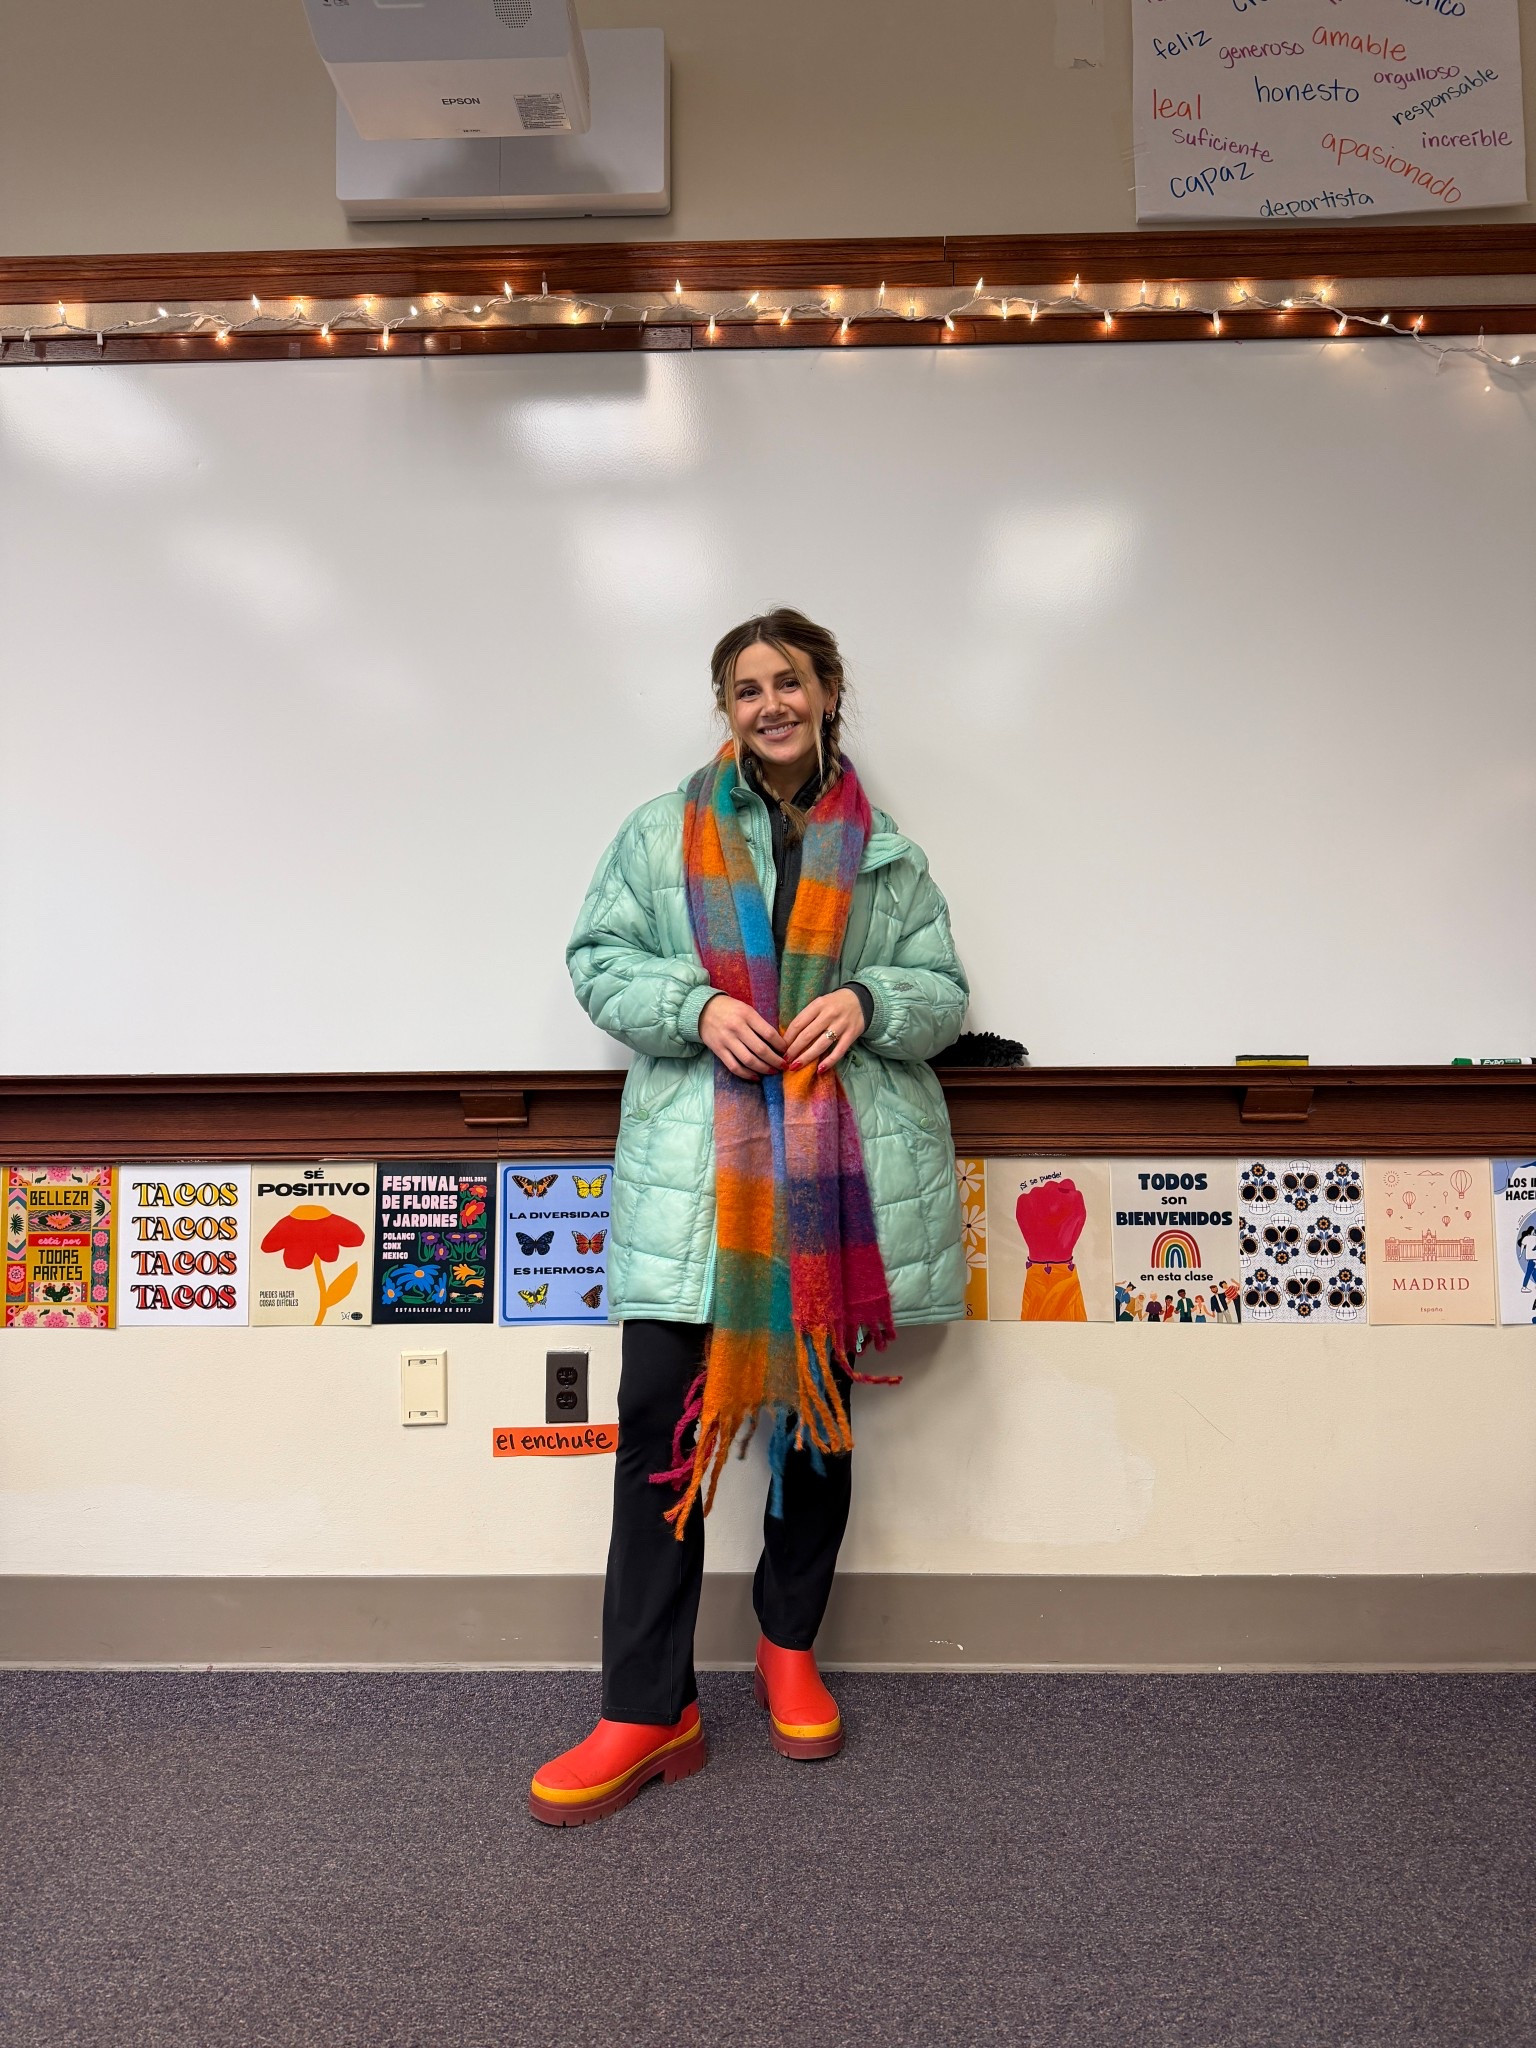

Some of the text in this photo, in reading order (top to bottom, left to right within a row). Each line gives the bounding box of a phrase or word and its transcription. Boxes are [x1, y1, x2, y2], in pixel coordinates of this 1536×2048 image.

[1154, 30, 1213, 60] feliz
[1312, 26, 1407, 62] amable
[1218, 40, 1305, 69] generoso
[1373, 64, 1460, 90] orgulloso
[1254, 76, 1360, 104] honesto
[1391, 67, 1499, 125] responsable
[441, 97, 480, 106] EPSON
[1153, 89, 1201, 121] leal
[1172, 127, 1274, 164] suficiente
[1421, 130, 1513, 149] increíble
[1321, 132, 1462, 204] apasionado
[1170, 161, 1254, 199] capaz
[1260, 187, 1374, 218] deportista
[304, 1167, 325, 1179] SÉ
[1039, 1171, 1063, 1183] puede!
[258, 1182, 370, 1196] POSITIVO
[383, 1175, 458, 1191] FESTIVAL
[1138, 1173, 1208, 1191] TODOS
[1507, 1177, 1527, 1188] LOS
[30, 1190, 89, 1206] BELLEZA
[132, 1182, 239, 1206] TACOS
[382, 1194, 458, 1210] DE FLORES
[1161, 1196, 1187, 1205] son
[1505, 1190, 1536, 1201] HACE
[382, 1213, 458, 1229] Y JARDINES
[509, 1211, 610, 1220] LA DIVERSIDAD
[1116, 1211, 1233, 1226] BIENVENIDOS
[132, 1216, 239, 1241] TACOS
[383, 1232, 416, 1241] POLANCO
[38, 1237, 81, 1248] está por
[383, 1242, 402, 1250] CDMX
[38, 1249, 79, 1265] TODAS
[131, 1250, 238, 1275] TACOS
[33, 1265, 83, 1281] PARTES
[513, 1266, 606, 1276] ES HERMOSA
[1140, 1271, 1214, 1282] en esta clase
[1392, 1277, 1471, 1291] MADRID
[130, 1284, 237, 1310] TACOS
[259, 1290, 295, 1299] PUEDES HACER
[259, 1299, 276, 1307] COSAS
[496, 1429, 613, 1450] el enchufe
